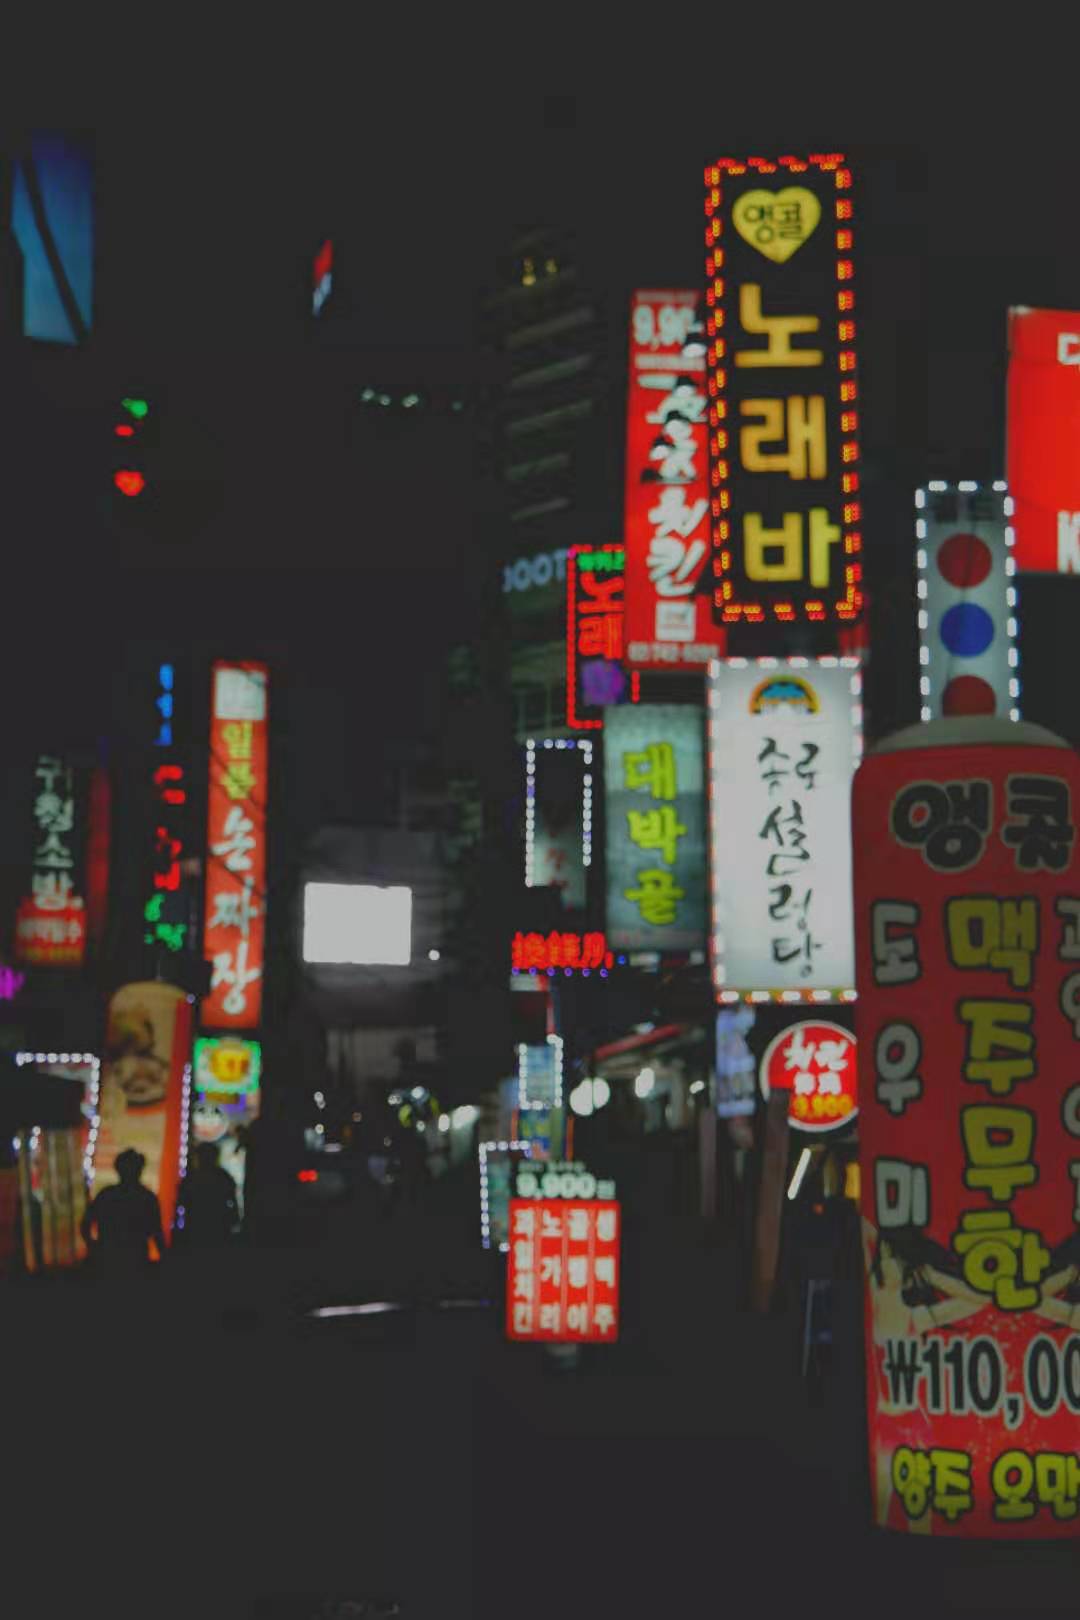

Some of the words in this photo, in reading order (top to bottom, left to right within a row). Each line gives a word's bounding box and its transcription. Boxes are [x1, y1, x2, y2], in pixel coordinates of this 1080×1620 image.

[733, 281, 841, 589] 노래바
[870, 899, 931, 1229] 도우미
[890, 1447, 973, 1522] 양주
